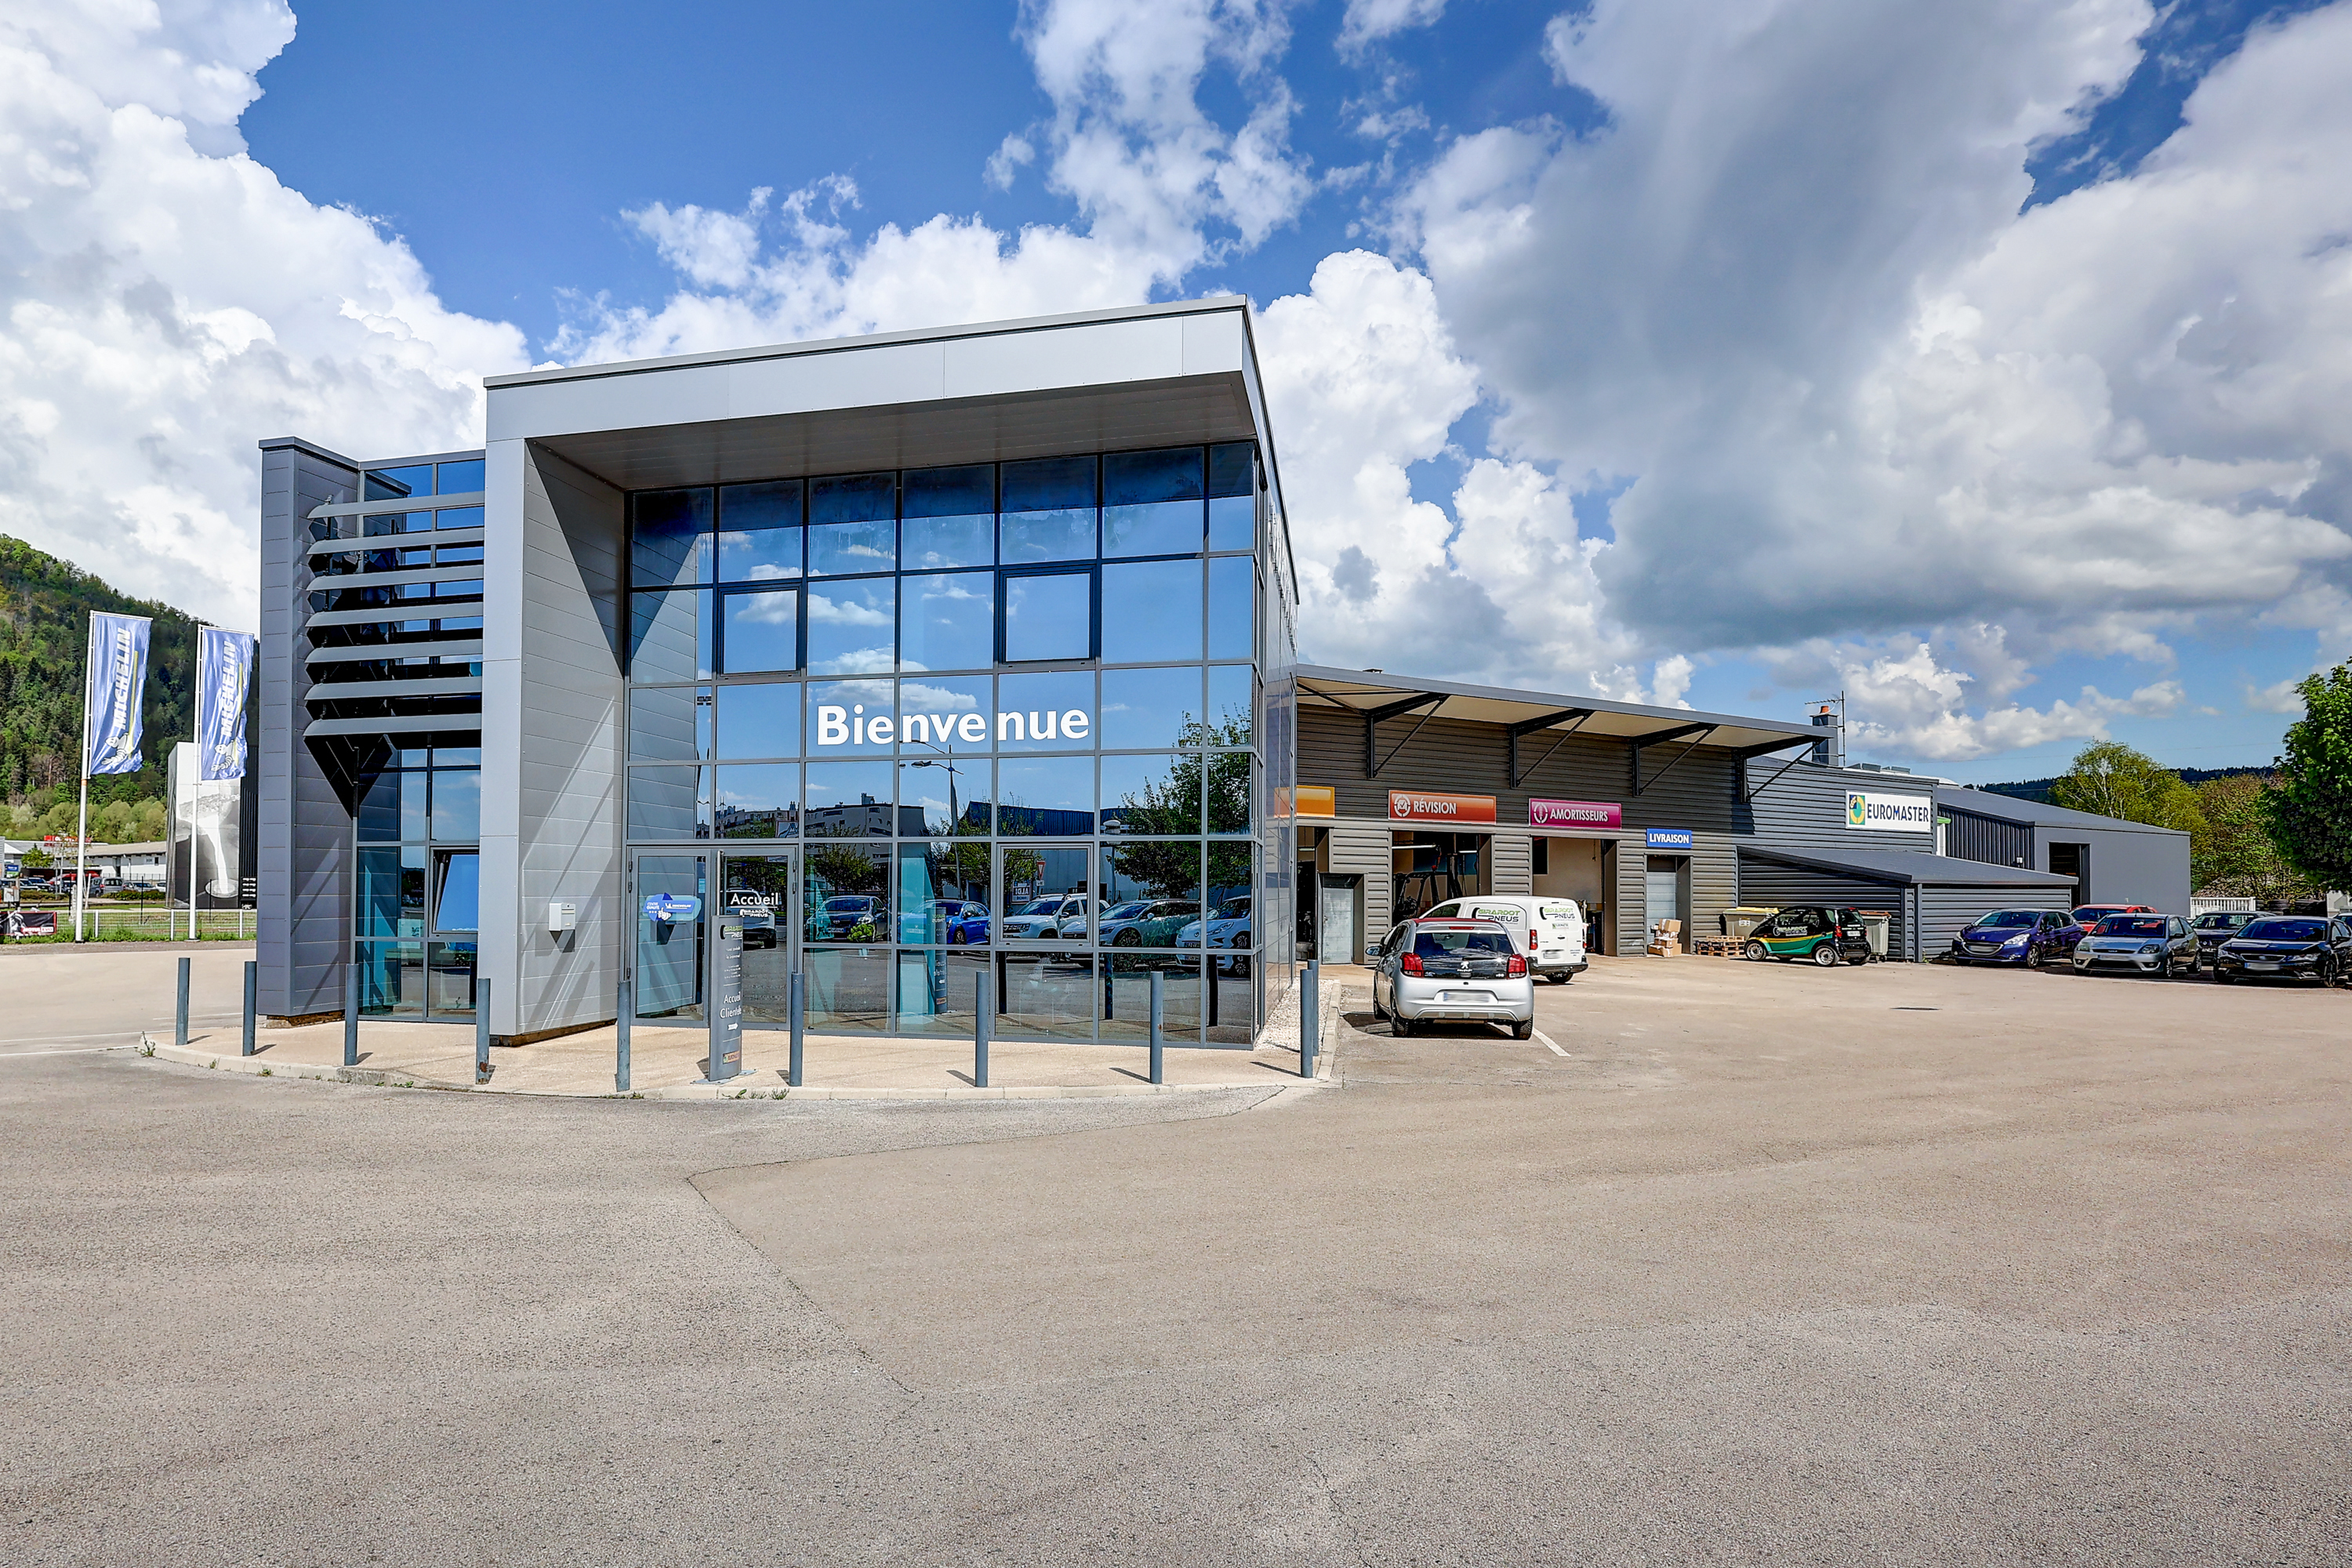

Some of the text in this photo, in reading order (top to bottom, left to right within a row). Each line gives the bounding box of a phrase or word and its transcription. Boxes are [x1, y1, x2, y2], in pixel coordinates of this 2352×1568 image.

[112, 627, 131, 730] MICHELIN
[220, 641, 236, 737] MICHELIN
[817, 703, 1090, 746] Bienvenue
[1413, 798, 1457, 815] RÉVISION
[1549, 808, 1608, 822] AMORTISSEURS
[1867, 803, 1929, 822] EUROMASTER
[1649, 833, 1690, 844] LIVRAISON
[730, 892, 779, 905] Accueil
[1488, 914, 1519, 923] PNEUS
